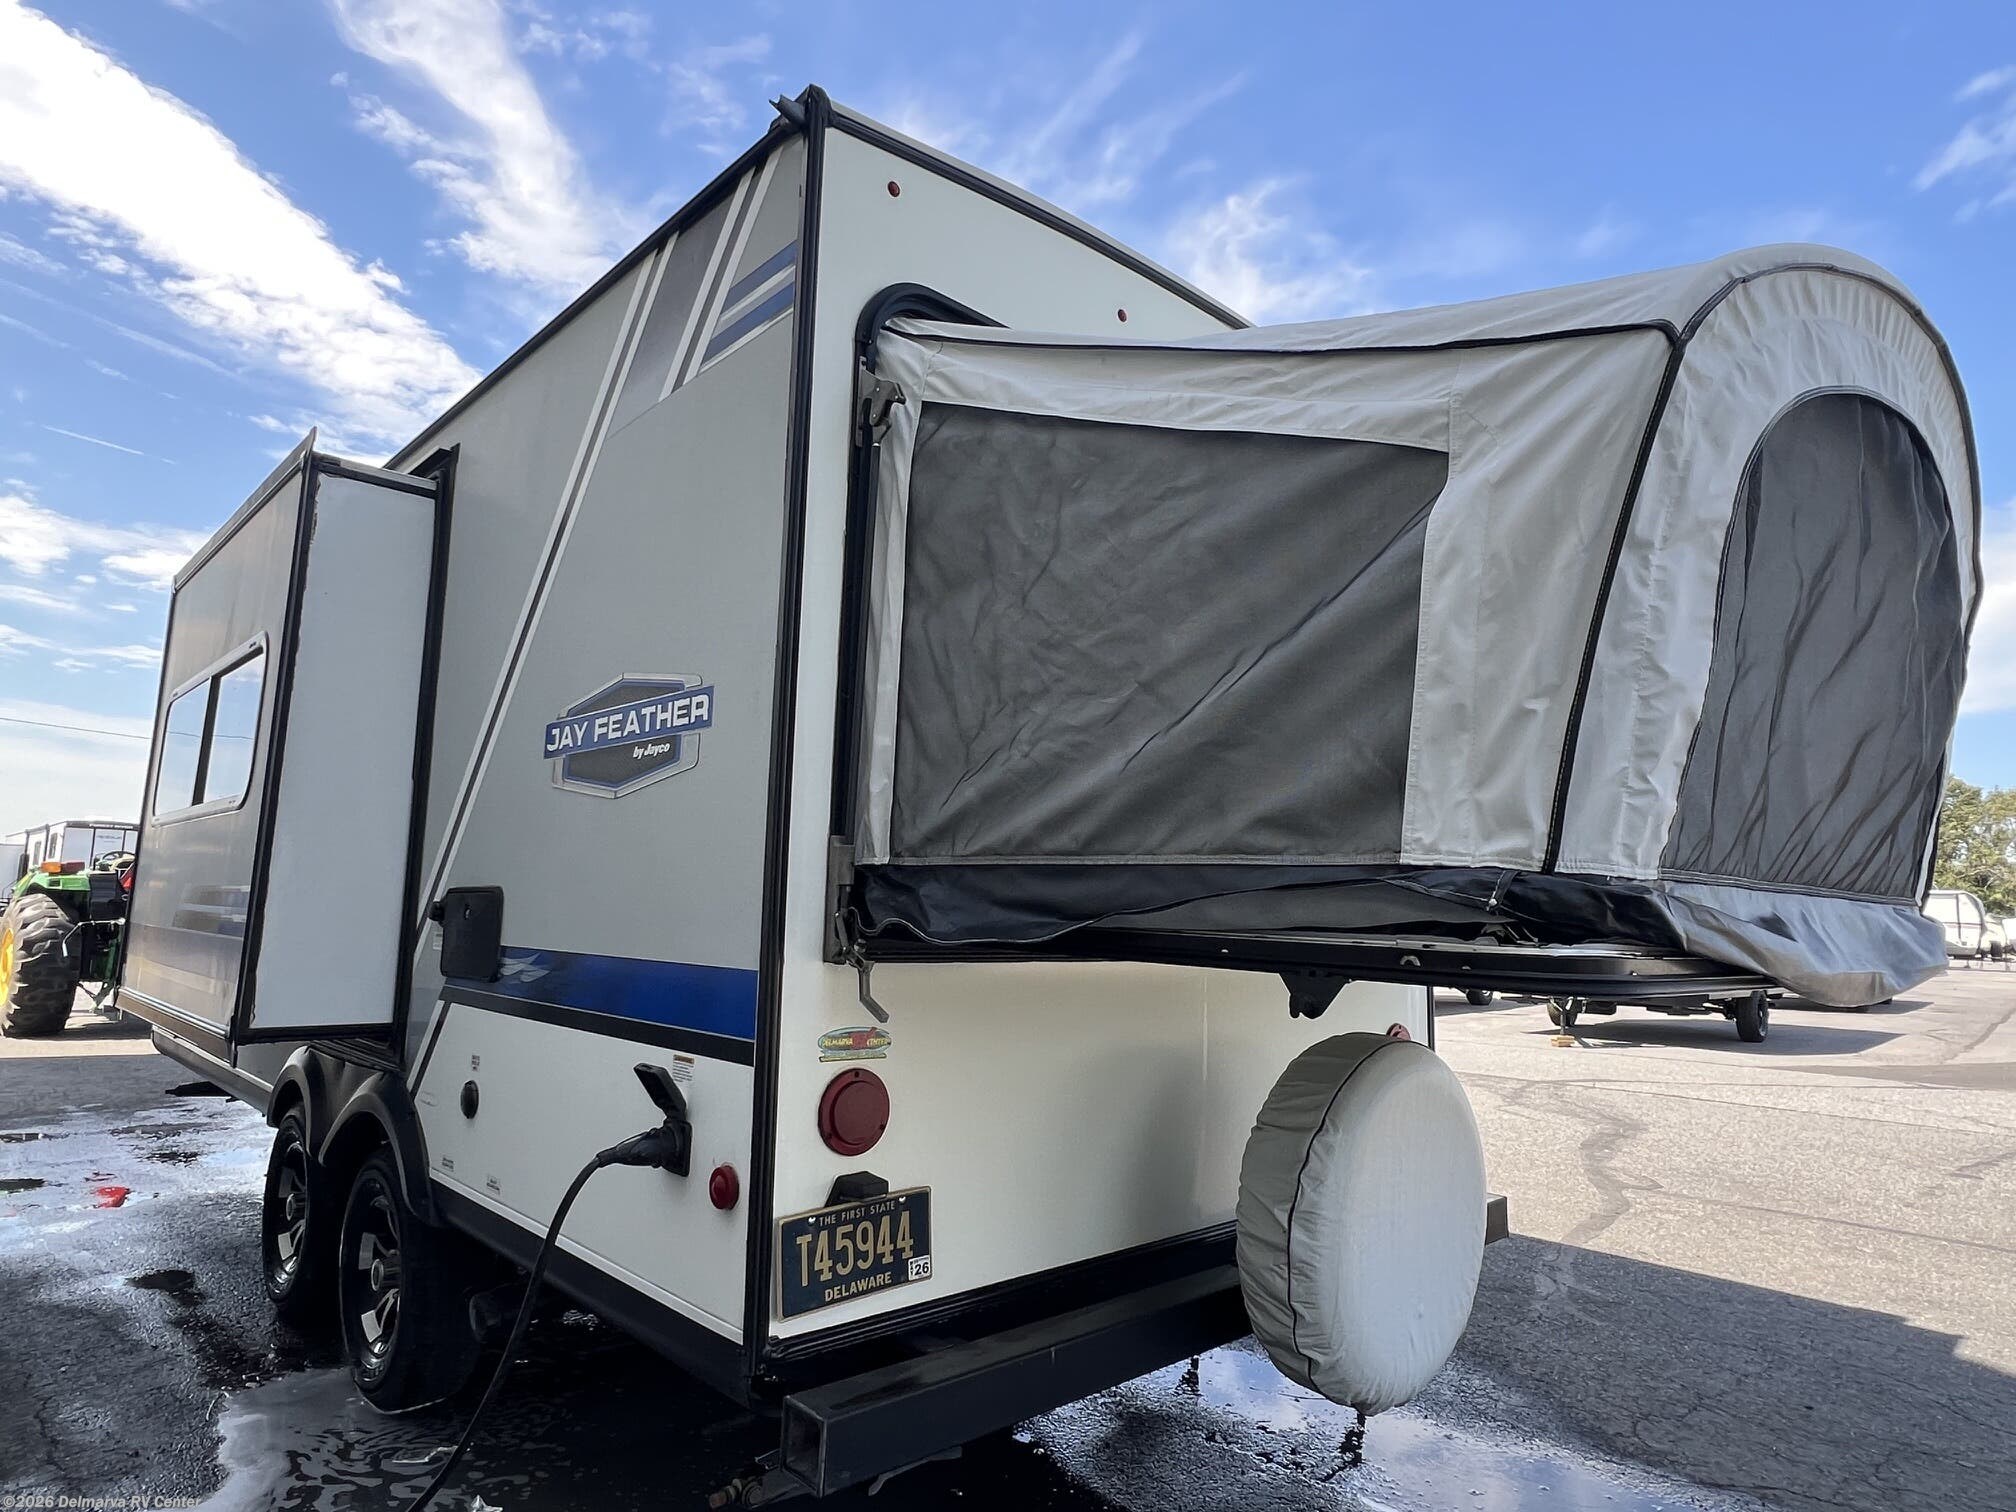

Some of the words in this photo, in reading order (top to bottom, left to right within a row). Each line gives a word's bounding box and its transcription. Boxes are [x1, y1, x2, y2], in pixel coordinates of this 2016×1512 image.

[546, 721, 588, 752] JAY
[593, 694, 710, 743] FEATHER
[632, 746, 645, 760] by
[644, 743, 670, 757] Jayco
[819, 1214, 837, 1227] THE
[841, 1208, 865, 1223] FIRST
[870, 1200, 896, 1215] STATE
[796, 1210, 914, 1287] T45944
[914, 1261, 930, 1276] 26
[824, 1271, 892, 1302] DELAWARE
